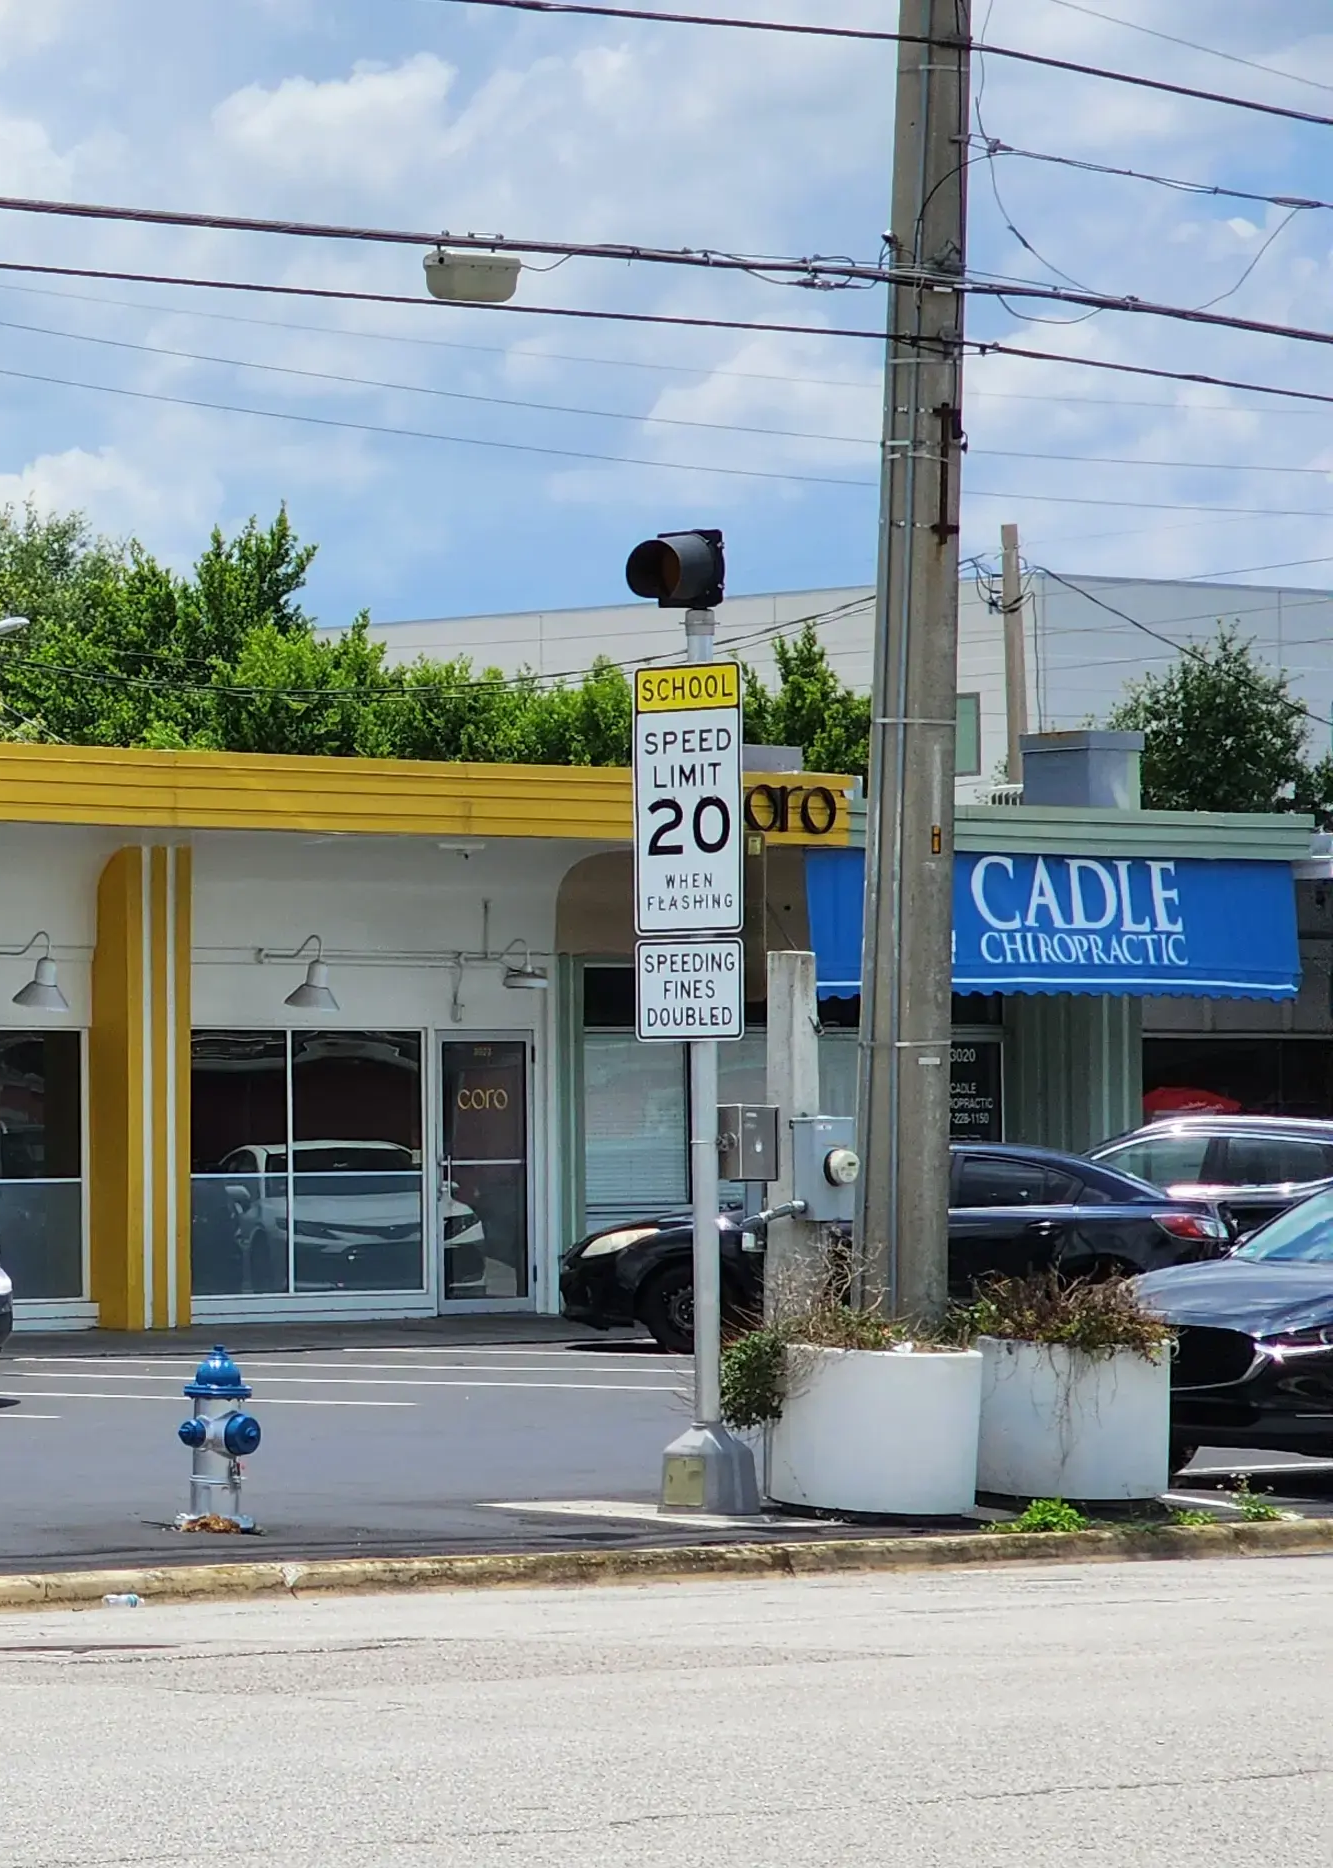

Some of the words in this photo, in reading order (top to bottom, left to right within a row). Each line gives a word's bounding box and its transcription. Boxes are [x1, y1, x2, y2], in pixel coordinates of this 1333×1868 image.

[642, 673, 733, 701] SCHOOL
[644, 728, 731, 755] SPEED
[653, 762, 721, 788] LIMIT
[744, 784, 836, 834] oro
[647, 796, 730, 856] 20
[665, 873, 713, 889] WHEN
[647, 894, 733, 911] FLASHING
[971, 855, 1183, 932] CADLE
[980, 932, 1189, 965] CHIROPRACTIC
[644, 952, 735, 973] SPEEDING
[663, 979, 716, 1000] FINES
[647, 1007, 733, 1027] DOUBLED
[950, 1048, 976, 1062] 3020
[457, 1088, 508, 1109] coro
[949, 1083, 977, 1094] CADLE
